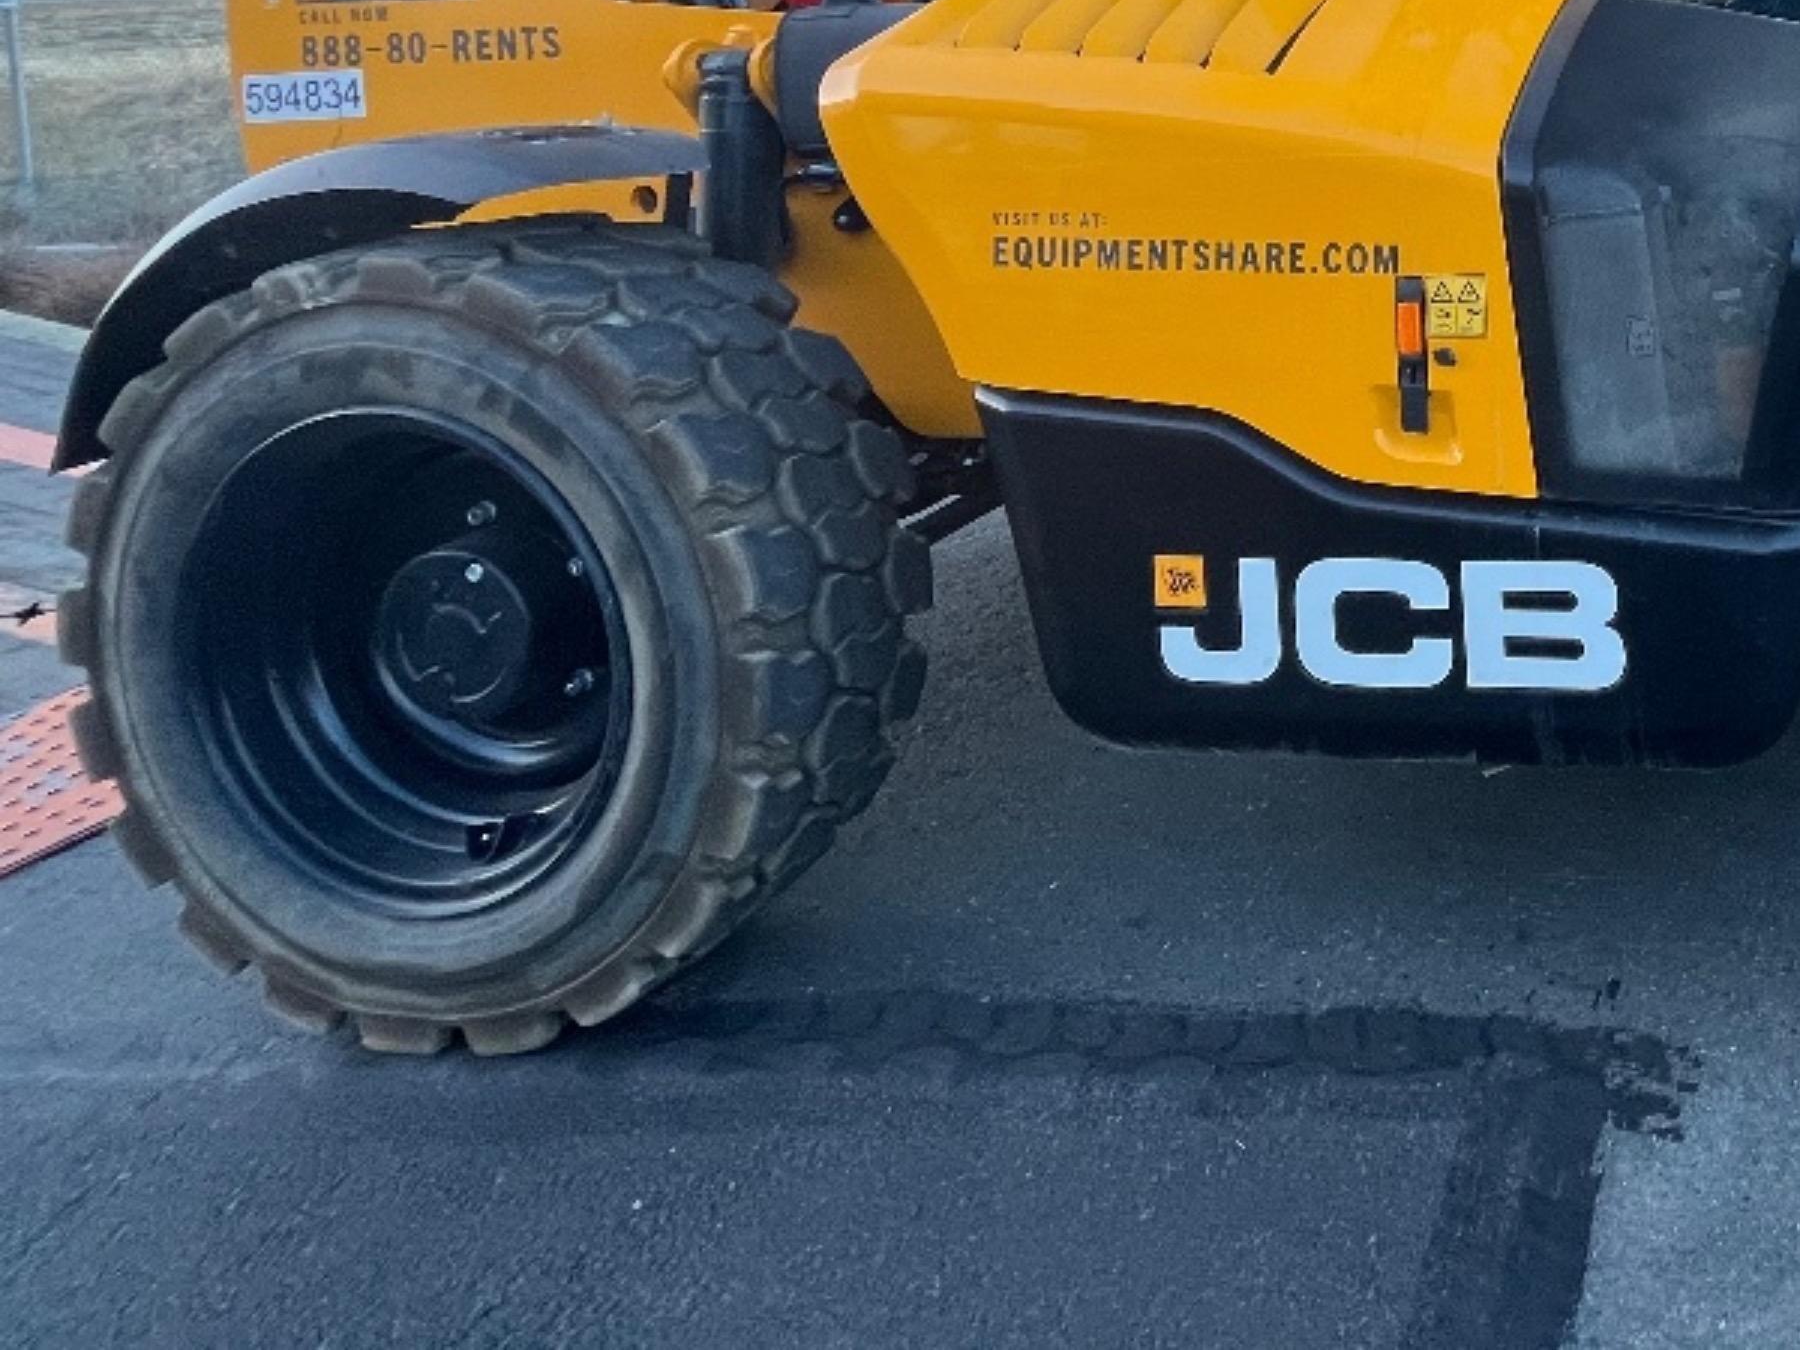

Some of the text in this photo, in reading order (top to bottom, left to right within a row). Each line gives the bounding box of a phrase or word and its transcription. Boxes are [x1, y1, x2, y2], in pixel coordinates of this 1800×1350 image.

[299, 6, 389, 24] CALL NOW
[301, 26, 561, 66] 888-80-RENTS
[245, 78, 361, 114] 594834
[992, 211, 1040, 226] VISIT
[1049, 212, 1071, 226] US
[992, 236, 1400, 275] EQUIPMENTSHARE.COM
[1159, 557, 1628, 692] JCB
